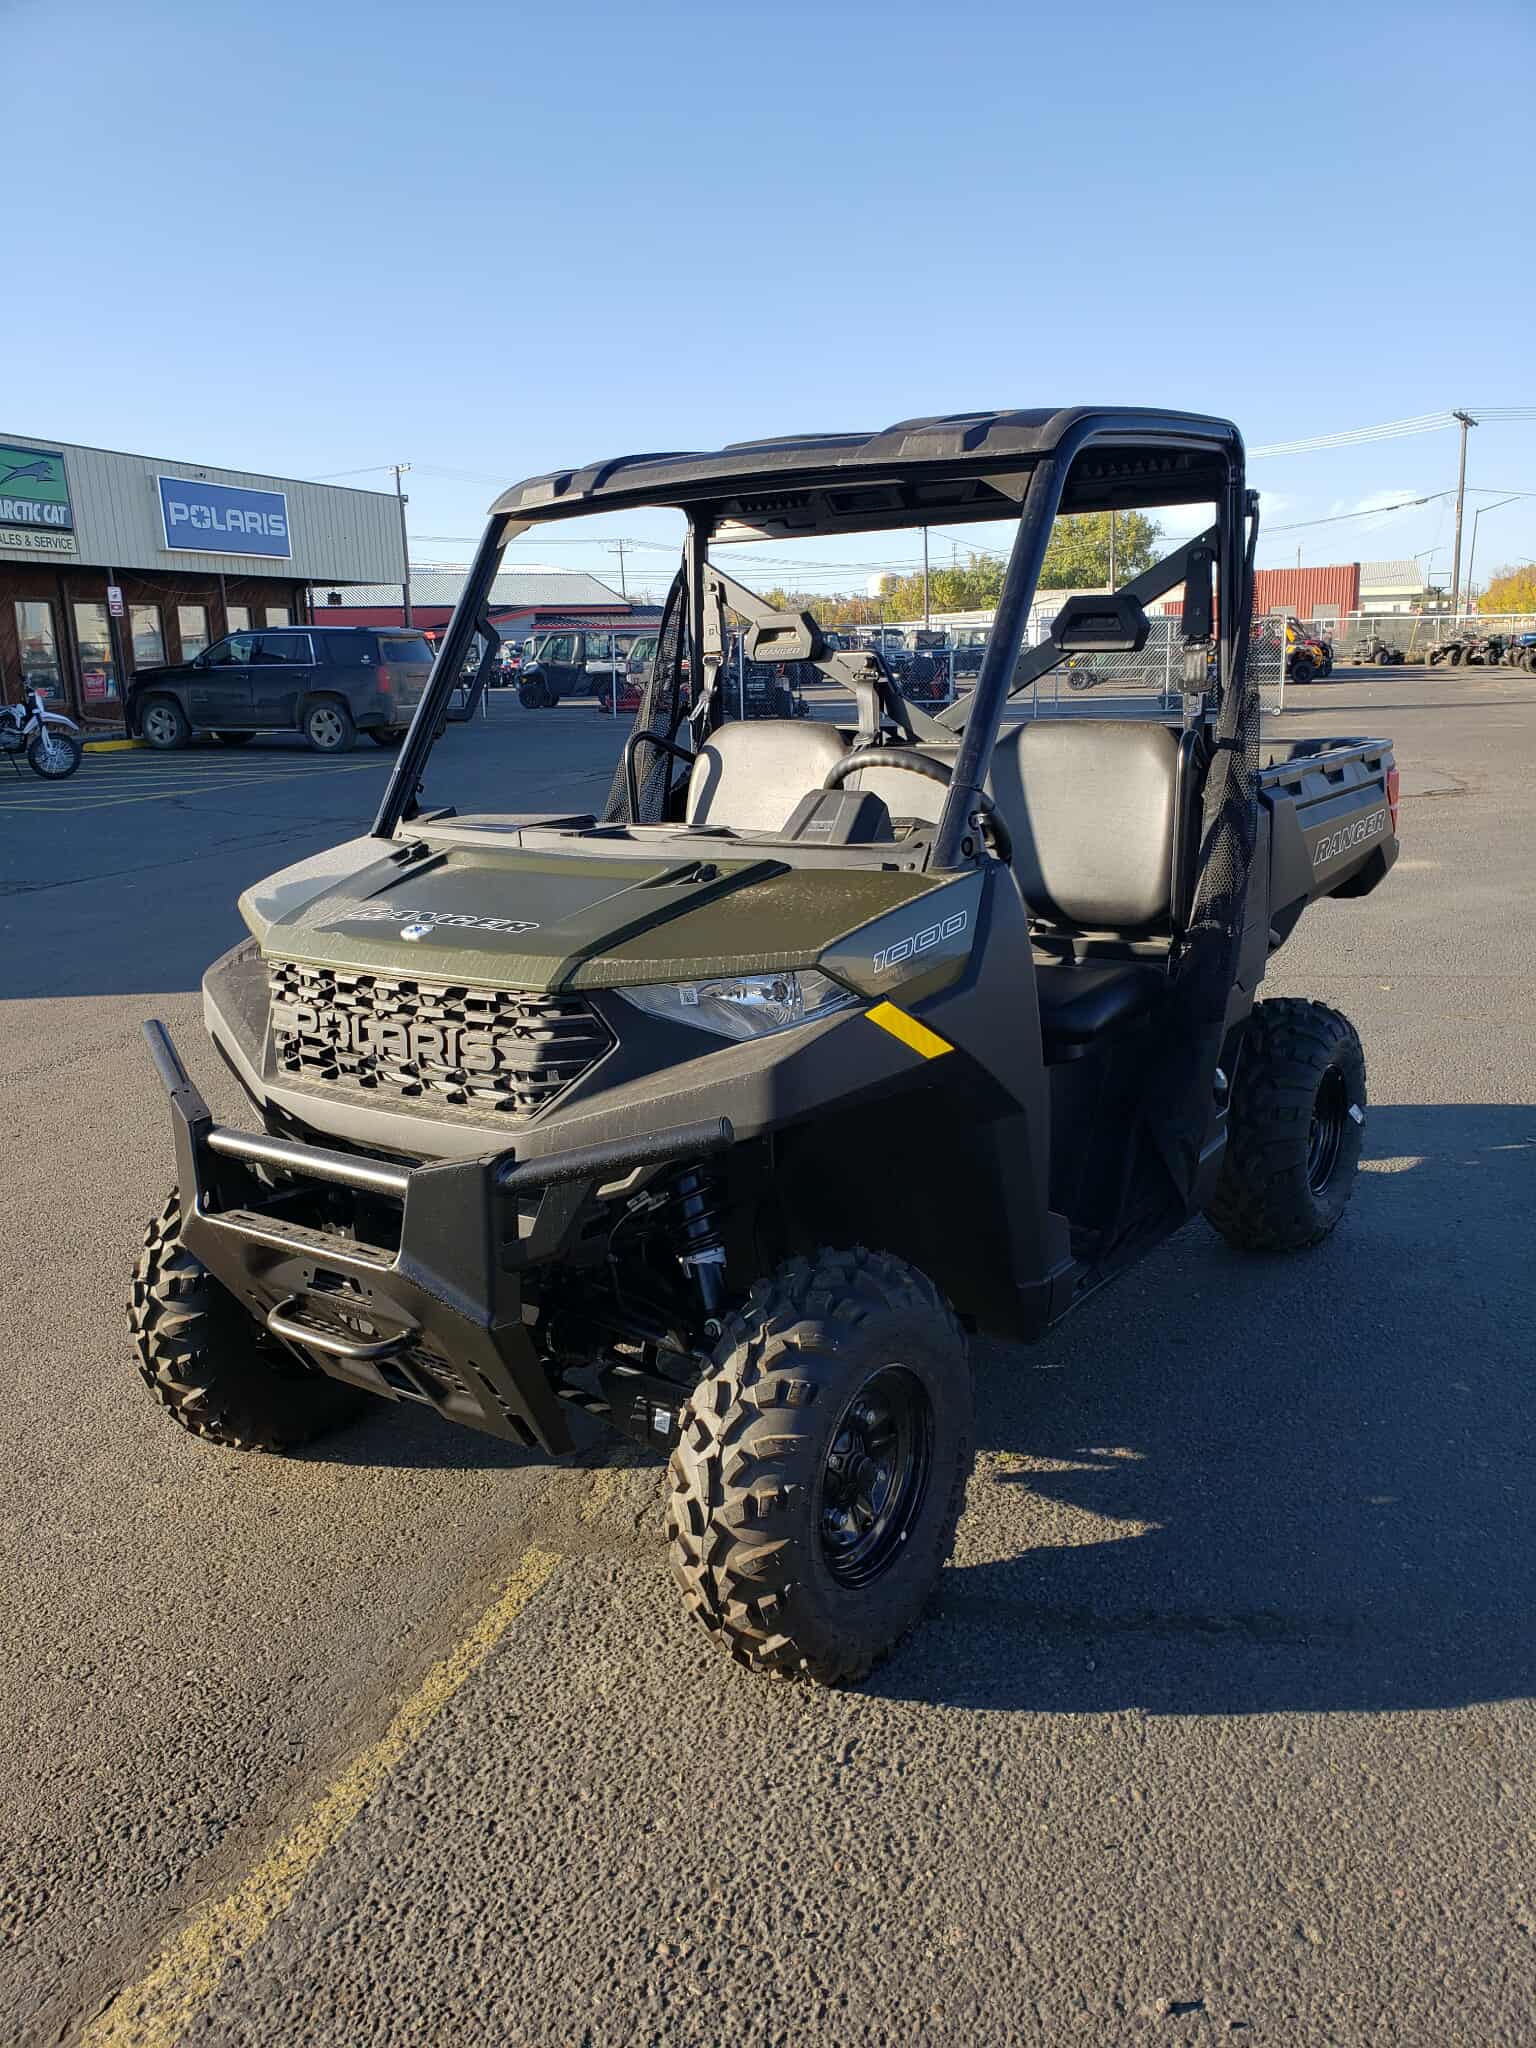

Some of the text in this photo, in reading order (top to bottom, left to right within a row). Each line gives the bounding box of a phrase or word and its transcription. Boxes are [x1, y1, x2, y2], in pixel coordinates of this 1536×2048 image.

[43, 505, 66, 524] CAT
[168, 501, 287, 537] POLARIS
[25, 535, 31, 546] &
[34, 536, 73, 550] SERVICE
[1313, 808, 1386, 865] RANGER
[347, 907, 540, 933] RANGER
[873, 910, 967, 974] 1000
[290, 1005, 497, 1071] POLARIS
